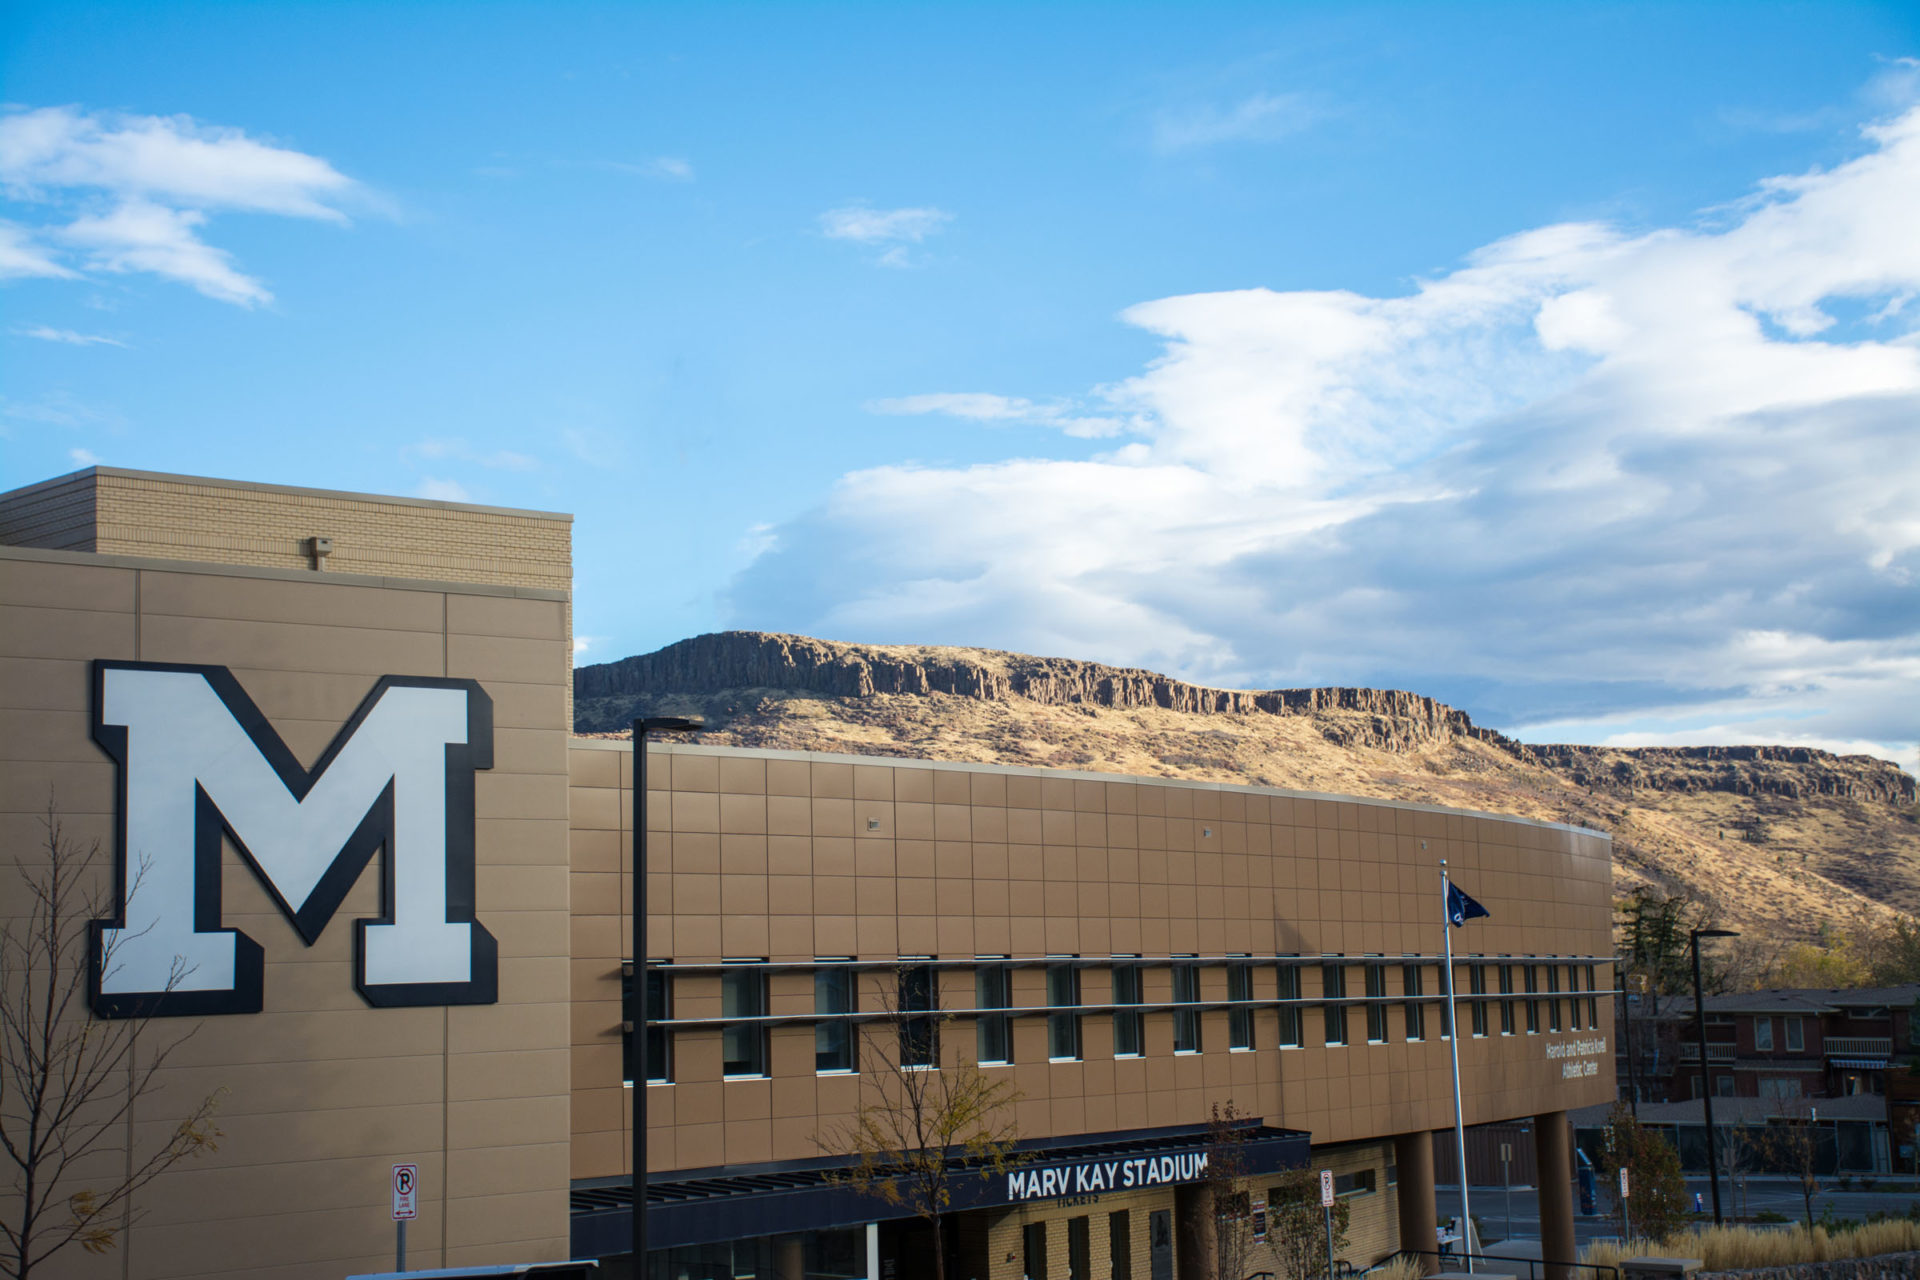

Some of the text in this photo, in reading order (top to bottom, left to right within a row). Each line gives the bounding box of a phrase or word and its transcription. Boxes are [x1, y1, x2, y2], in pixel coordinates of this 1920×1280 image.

[92, 660, 497, 1018] M
[1546, 1041, 1566, 1059] Harold
[1566, 1039, 1577, 1057] and
[1577, 1038, 1595, 1056] Patricia
[1562, 1060, 1599, 1079] Athletic Center
[1008, 1152, 1209, 1200] MARV KAY STADIUM
